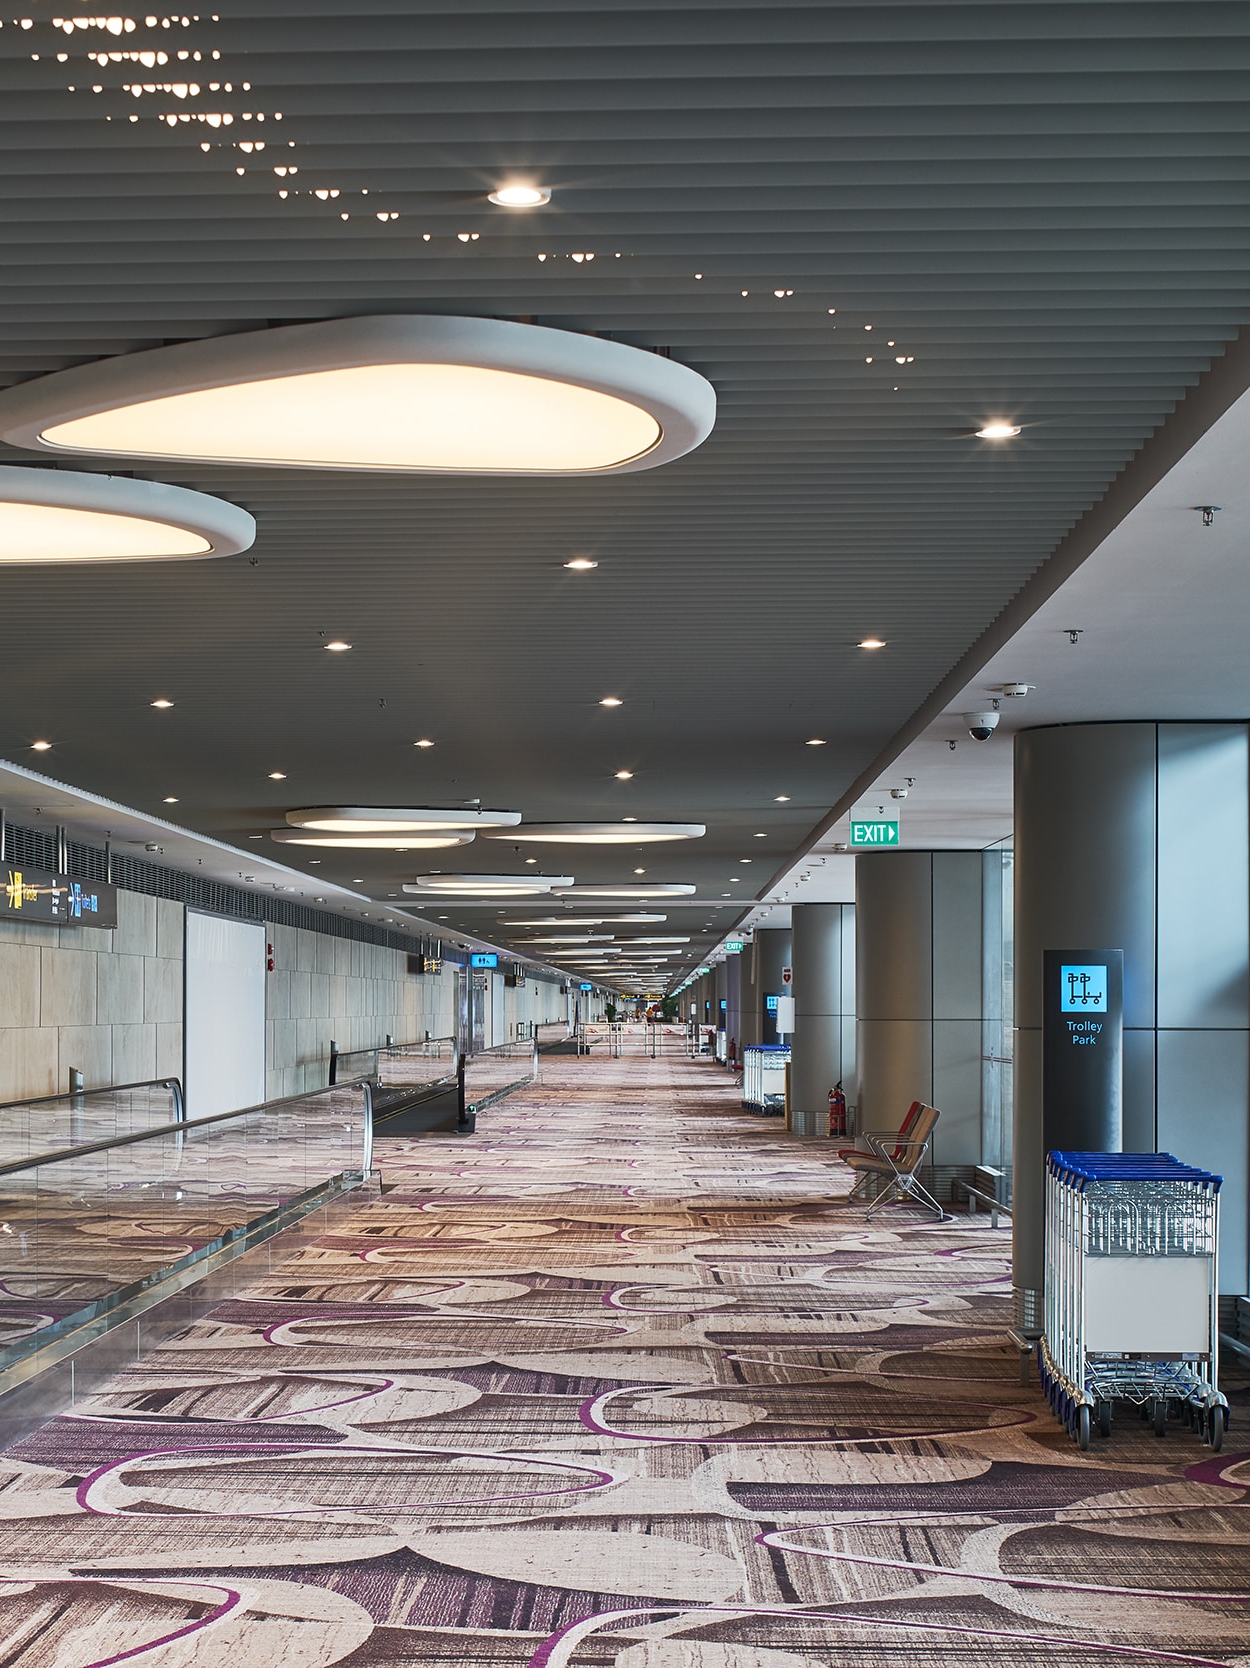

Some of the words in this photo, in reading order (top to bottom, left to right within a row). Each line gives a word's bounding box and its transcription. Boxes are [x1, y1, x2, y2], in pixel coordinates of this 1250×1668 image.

[854, 824, 887, 842] EXIT
[1066, 1021, 1103, 1033] Trolley
[1072, 1034, 1096, 1045] Park
